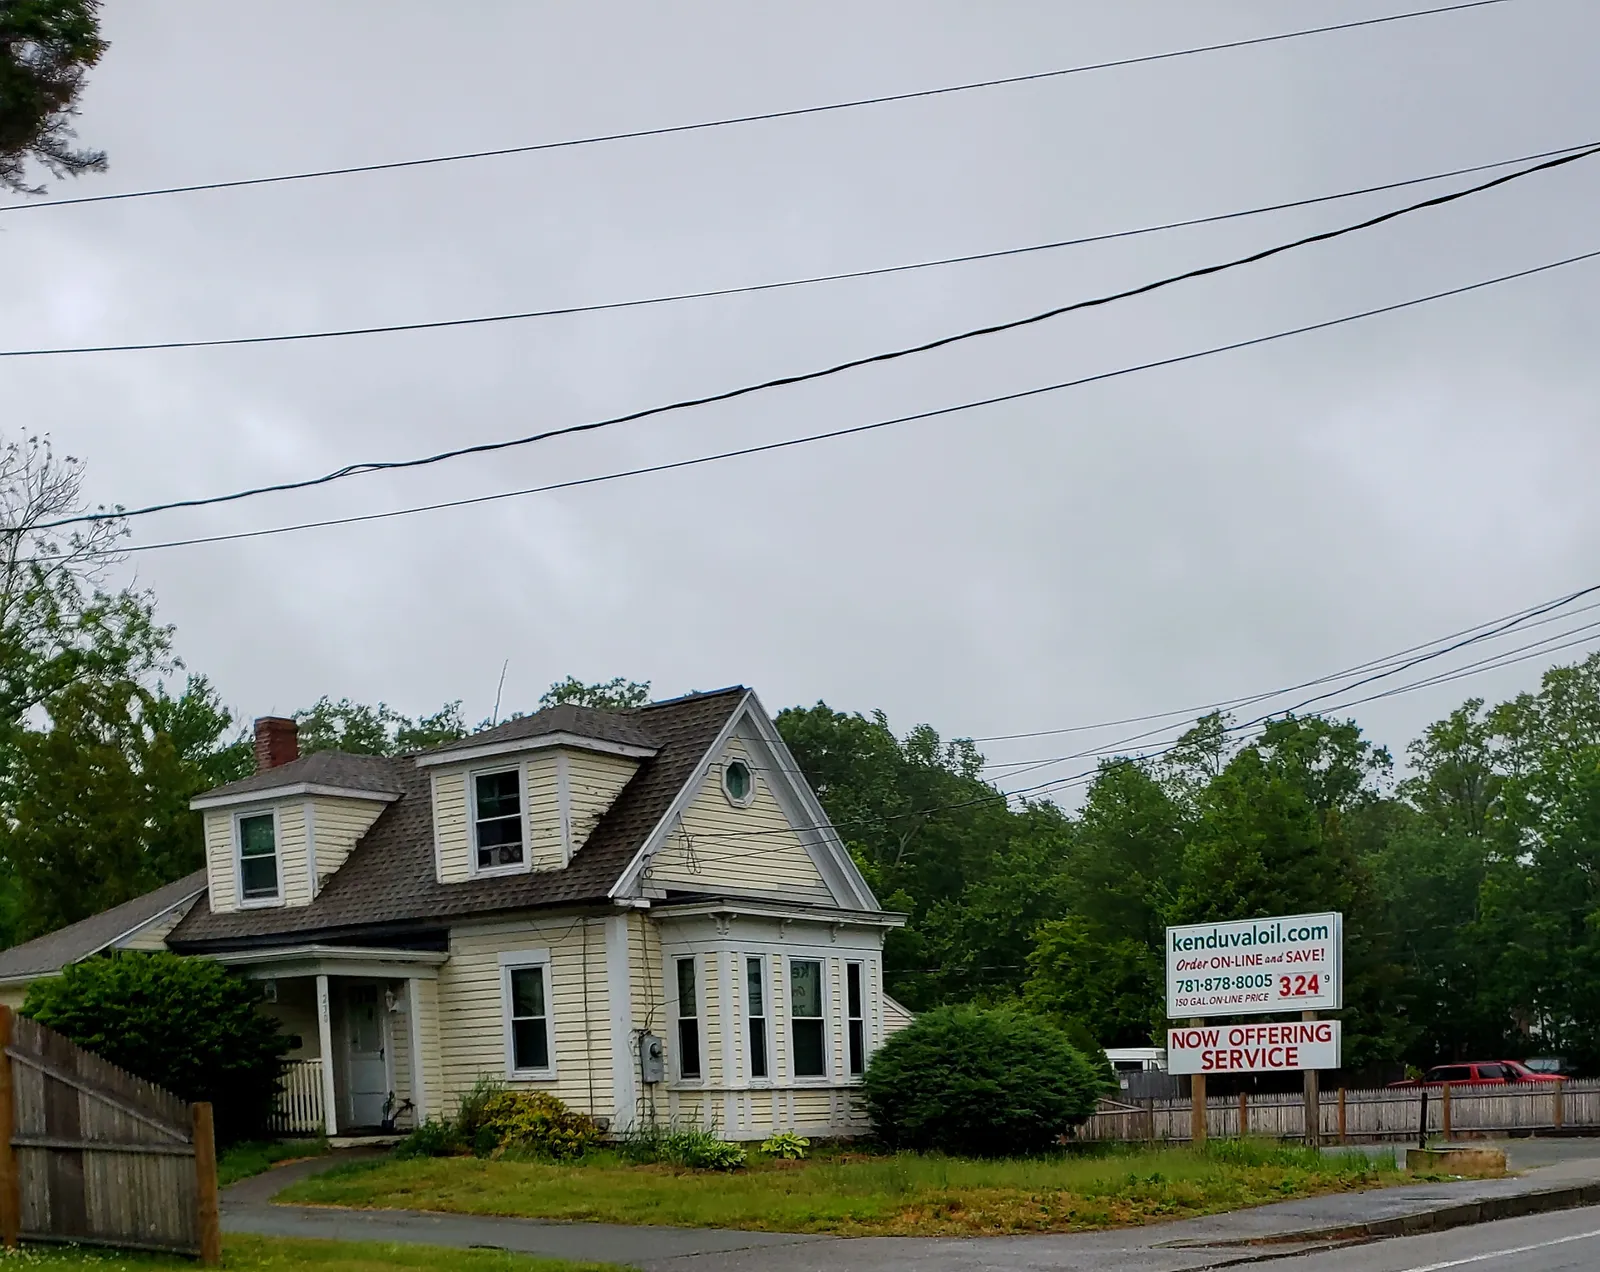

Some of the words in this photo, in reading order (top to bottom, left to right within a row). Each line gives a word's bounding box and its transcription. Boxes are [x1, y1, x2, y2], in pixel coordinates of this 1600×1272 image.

[1173, 923, 1328, 952] kenduvaloil.com
[1176, 957, 1208, 971] Order
[1210, 954, 1263, 969] ON-LINE
[1265, 953, 1284, 964] and
[1285, 948, 1325, 963] SAVE!
[1324, 974, 1331, 983] 9
[1175, 998, 1188, 1007] 150
[1245, 992, 1269, 1002] PRICE
[1172, 1030, 1220, 1049] NOW
[1228, 1024, 1332, 1046] OFFERING
[1201, 1047, 1299, 1070] SERVICE
